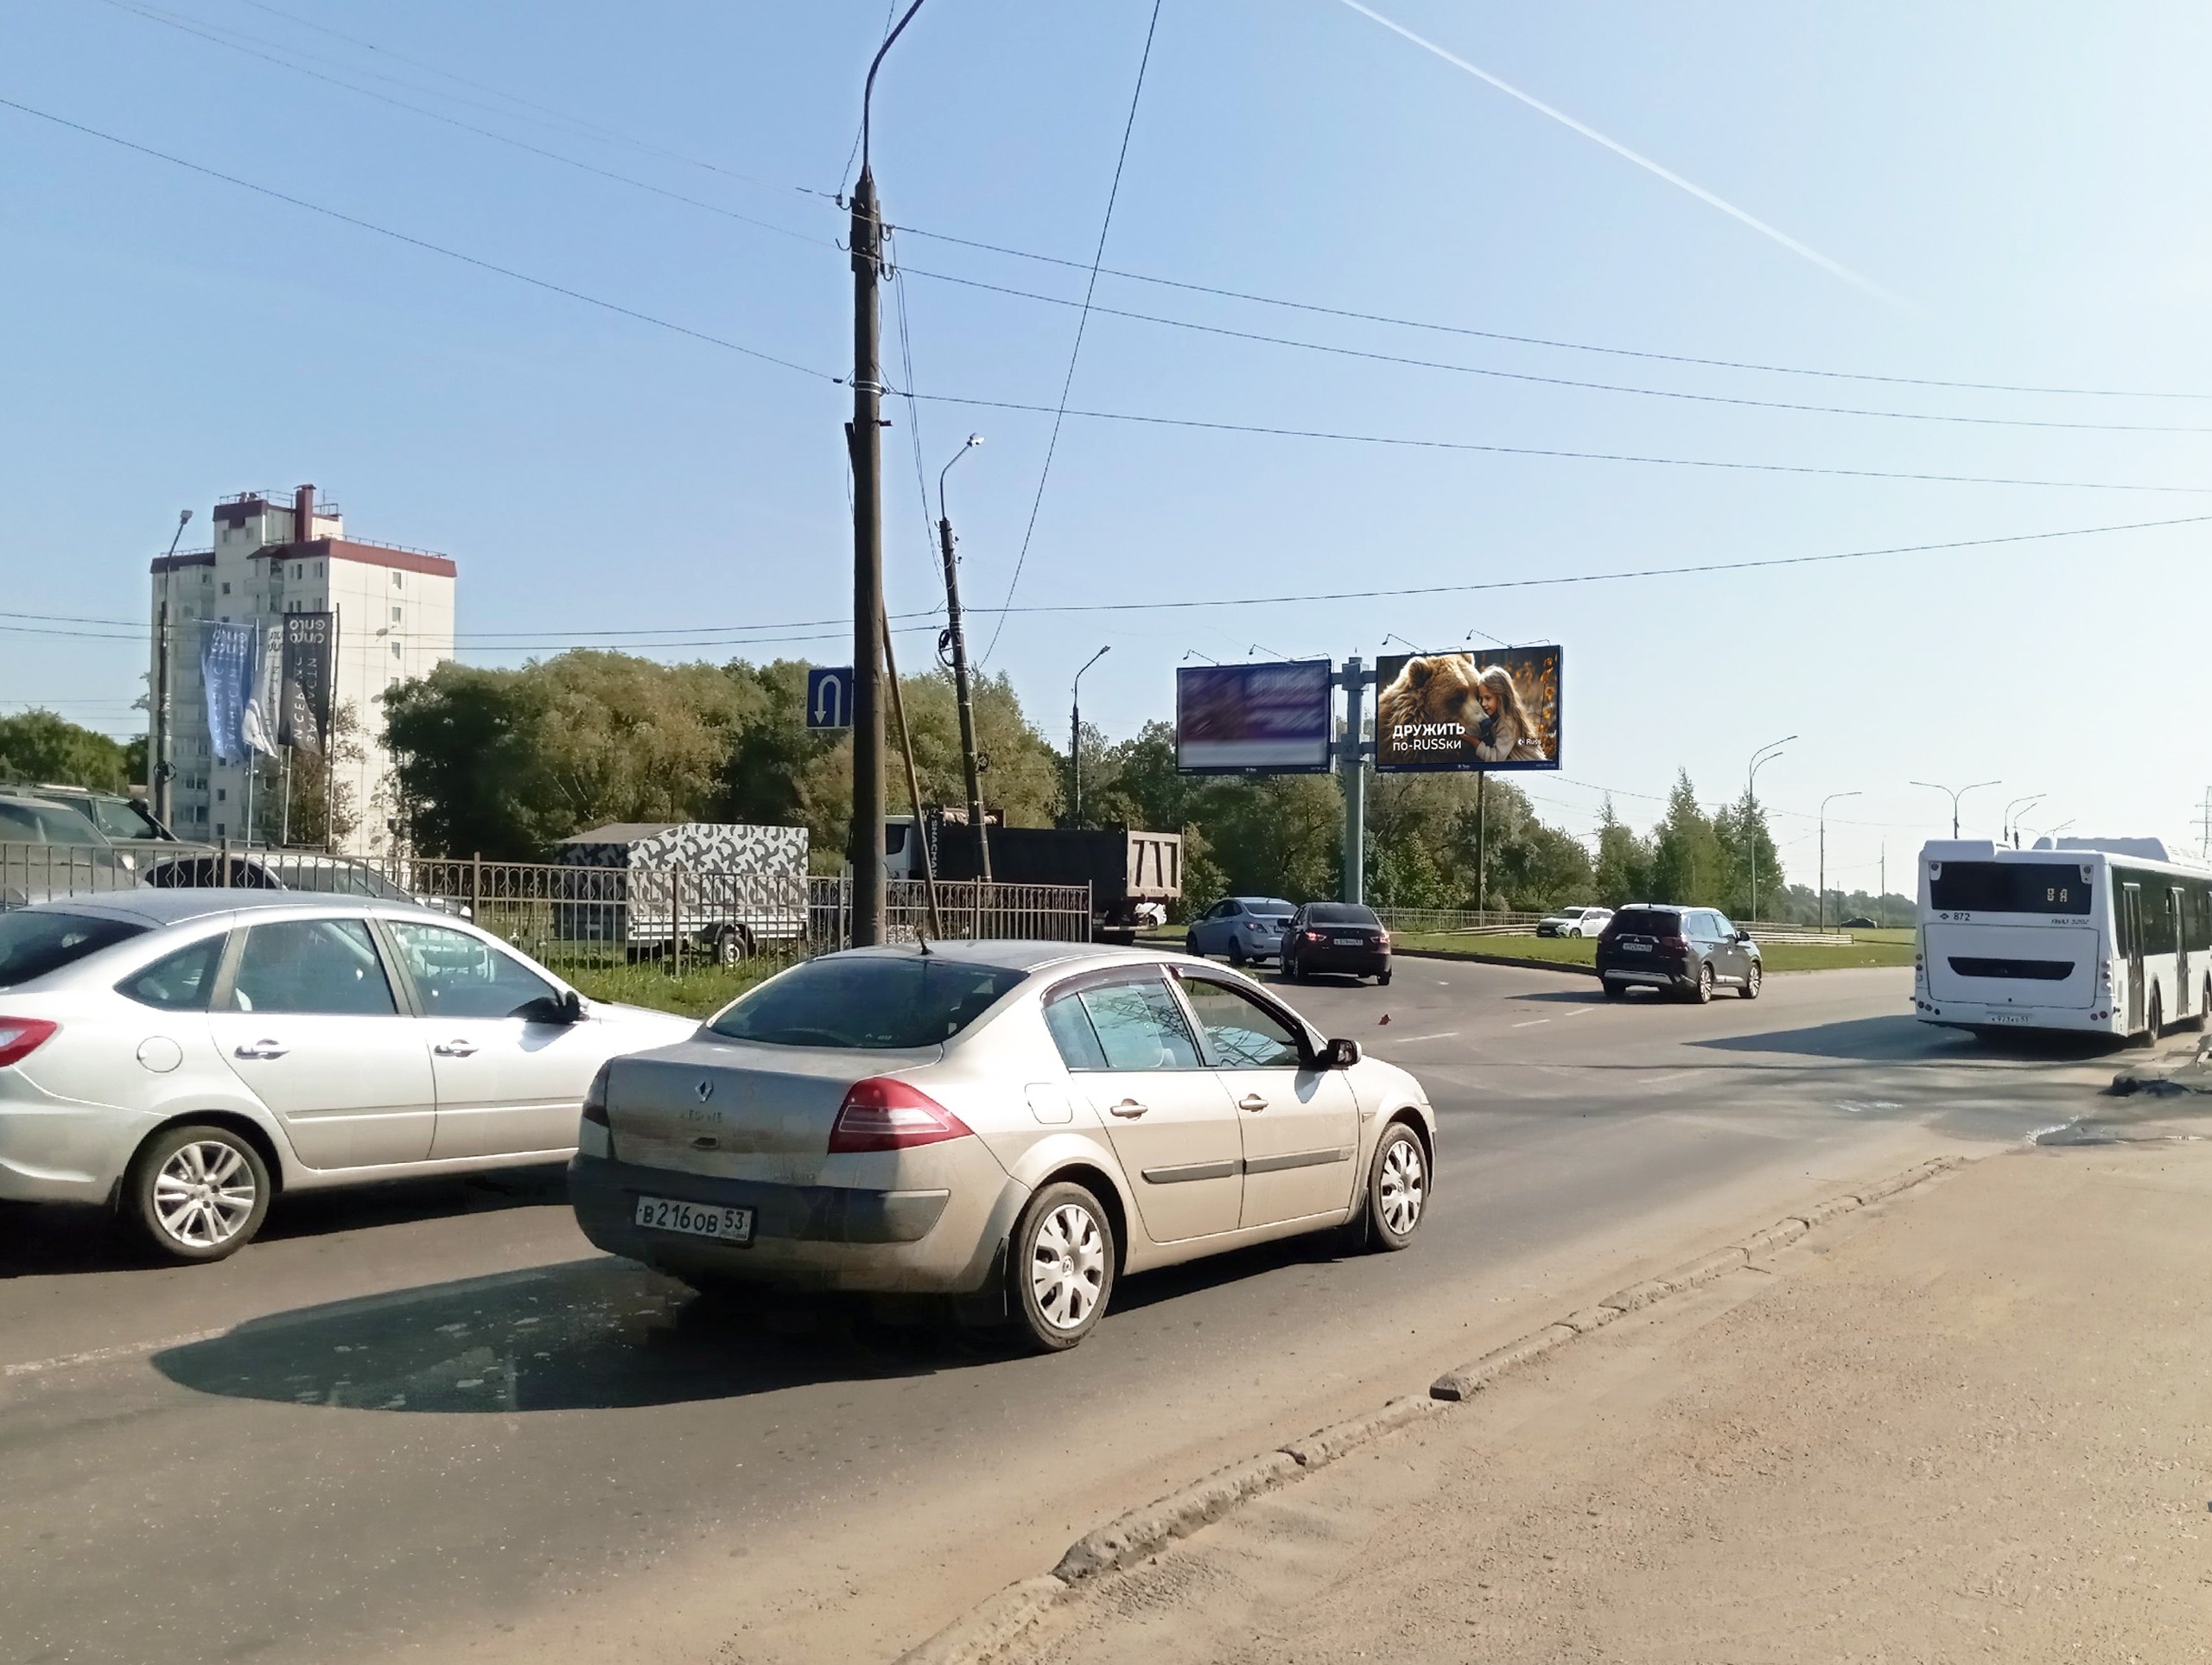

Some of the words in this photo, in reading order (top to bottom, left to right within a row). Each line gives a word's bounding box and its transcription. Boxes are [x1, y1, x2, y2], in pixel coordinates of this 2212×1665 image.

[1392, 722, 1466, 740] ДРУЖИТЬ
[1393, 738, 1462, 752] по-RUSSки
[1954, 912, 1970, 921] 872
